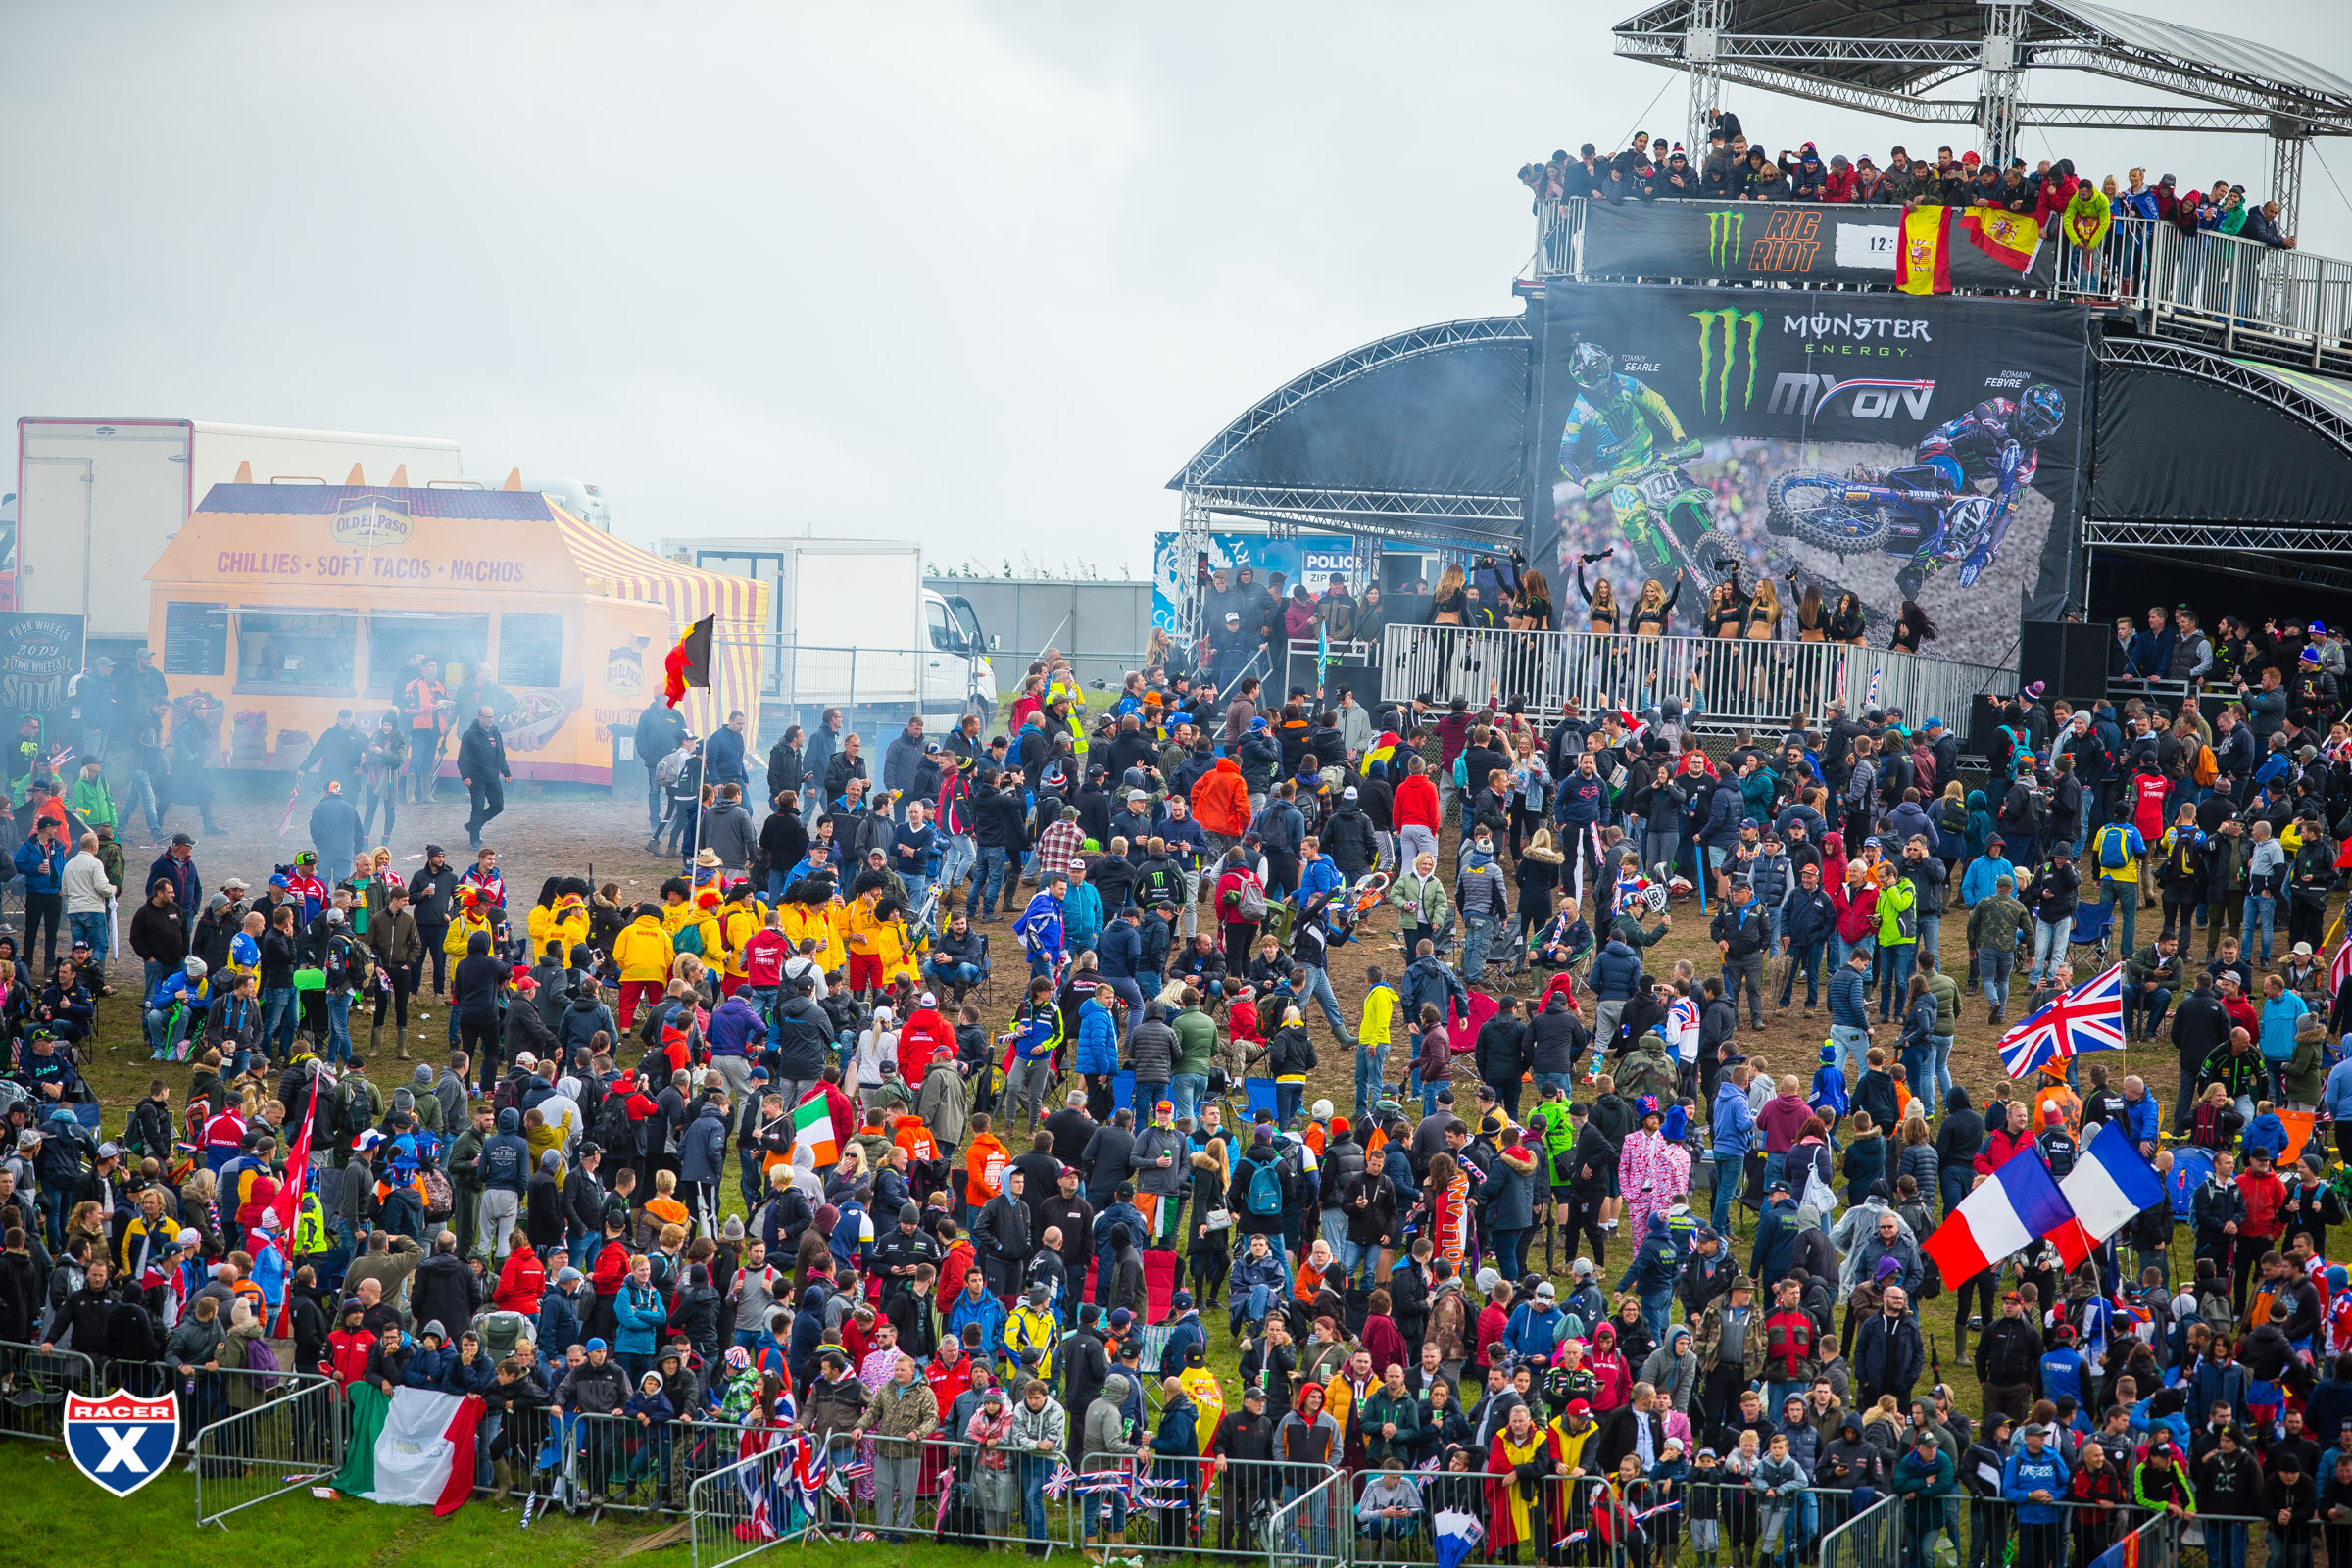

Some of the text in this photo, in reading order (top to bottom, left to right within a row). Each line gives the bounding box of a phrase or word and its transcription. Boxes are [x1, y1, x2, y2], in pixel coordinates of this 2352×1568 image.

[1765, 210, 1822, 241] RIG
[1748, 240, 1820, 272] RIOT
[1783, 312, 1933, 343] MONSTER
[1805, 344, 1908, 357] ENERGY
[1621, 354, 1646, 363] TOMMY
[1624, 363, 1661, 371] SEARLE
[2000, 369, 2032, 379] ROMAIN
[1984, 377, 2023, 388] FEBVRE
[336, 517, 360, 533] OLD
[360, 515, 377, 530] EL
[217, 551, 524, 582] CHILLIES SOFT TACOS NACHOS
[1310, 573, 1327, 583] ZIP
[9, 619, 72, 641] FOUR WHEELS
[16, 644, 60, 656] BODY
[14, 658, 62, 673] TWO WHEELS
[0, 674, 71, 712] SOUL
[594, 708, 615, 724] TASTY
[210, 1138, 238, 1147] HONDA
[2052, 1141, 2069, 1150] tyco
